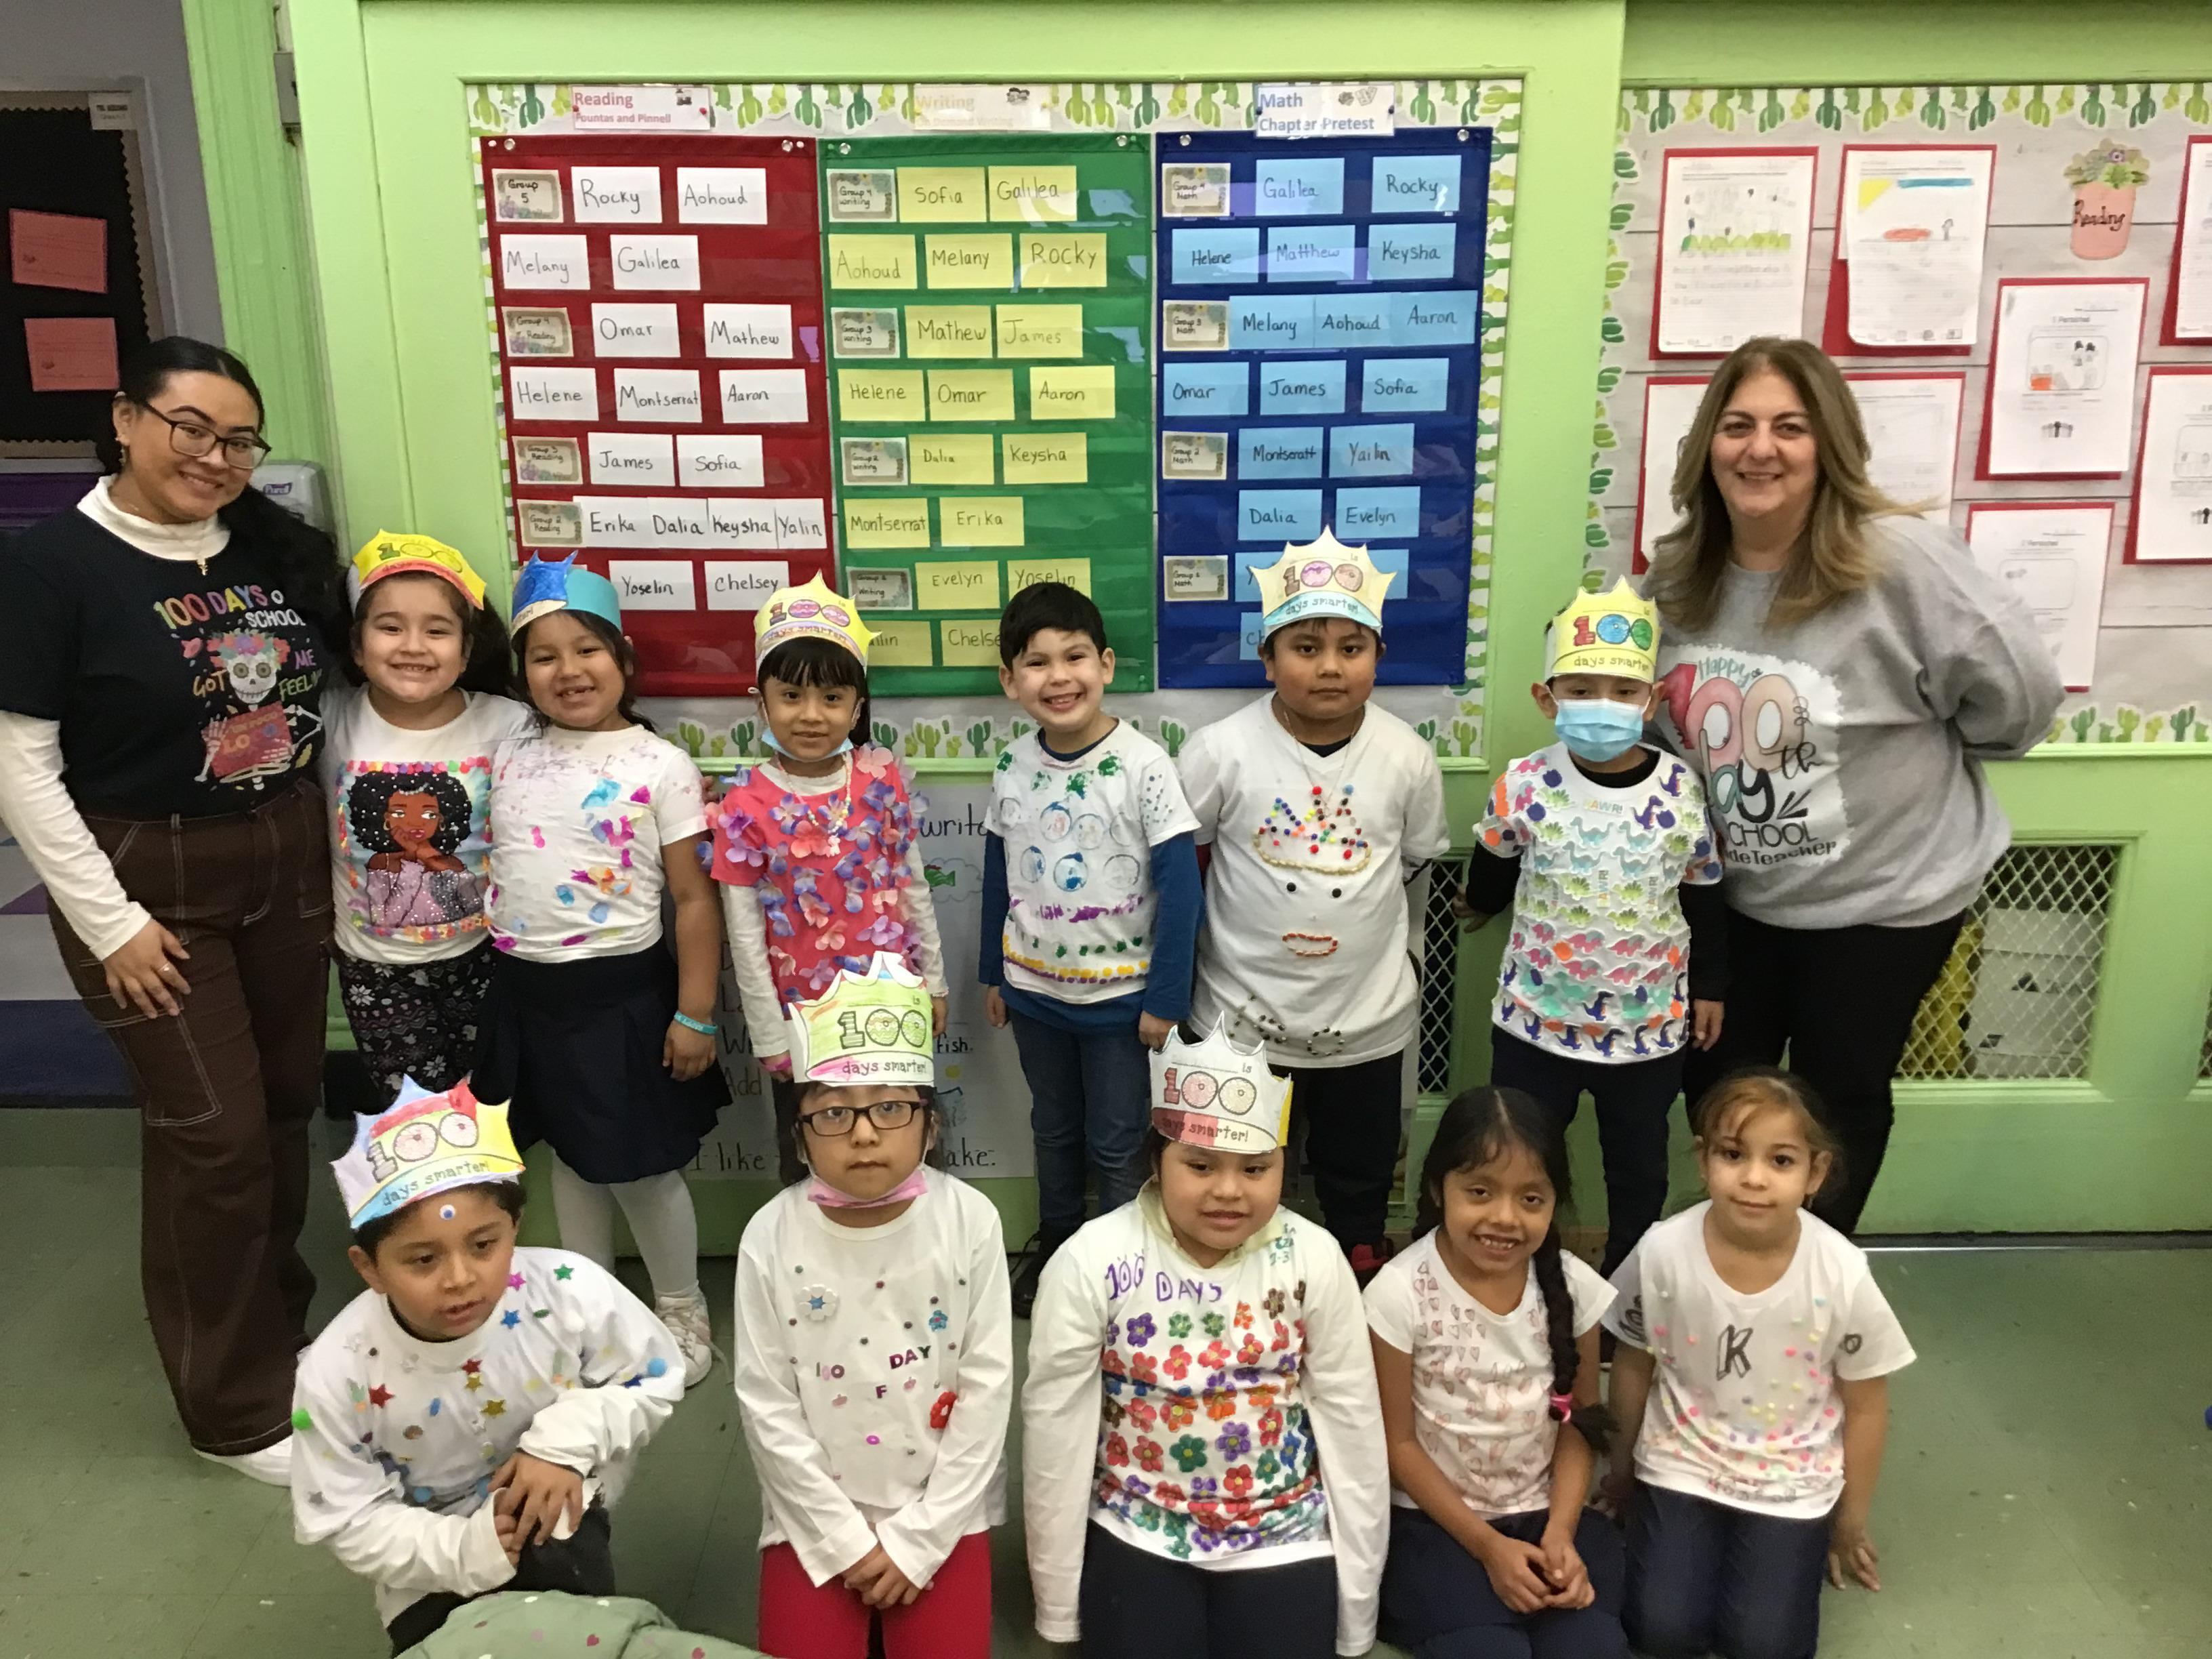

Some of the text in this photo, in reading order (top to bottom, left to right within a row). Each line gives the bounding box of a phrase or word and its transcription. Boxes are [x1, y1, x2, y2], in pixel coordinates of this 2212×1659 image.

[575, 93, 633, 108] Reading
[916, 96, 975, 110] Writing
[1260, 94, 1302, 108] Math
[617, 114, 634, 123] and
[638, 114, 671, 123] Pinnell
[1322, 118, 1375, 131] Pretest
[508, 180, 538, 190] Group
[840, 187, 863, 197] Group
[997, 178, 1059, 201] Galilea
[1174, 182, 1197, 192] Group
[1264, 177, 1318, 199] Galilea
[1387, 175, 1439, 201] Rocky
[521, 192, 529, 203] 5
[581, 179, 640, 213] Rocky
[915, 187, 962, 203] Sofia
[618, 247, 680, 272] Galilea
[933, 249, 989, 270] Melany
[1031, 241, 1097, 268] Rocky
[1193, 251, 1231, 264] Helene
[1277, 245, 1340, 261] Matthew
[1382, 241, 1440, 262] Keysha
[507, 251, 568, 283] Melany
[516, 316, 541, 326] Group
[600, 318, 652, 340] Omar
[842, 325, 865, 333] Group
[918, 320, 987, 340] Mathew
[1174, 317, 1194, 327] Group
[1243, 318, 1296, 340] Melany
[1408, 305, 1458, 325] Aaron
[712, 321, 779, 345] Mathew
[1003, 319, 1061, 344] James
[518, 382, 582, 403] Helene
[728, 383, 769, 401] Aaron
[851, 384, 906, 400] Helene
[938, 384, 987, 403] Omar
[1039, 382, 1085, 401] Aaron
[1173, 384, 1215, 399] Omar
[1269, 380, 1326, 397] James
[1375, 378, 1418, 396] Sofia
[600, 451, 653, 470] James
[853, 453, 872, 463] Group
[924, 449, 954, 463] Dalia
[1011, 445, 1067, 464] Keysha
[1172, 446, 1192, 456] Group
[696, 455, 741, 472] Sofia
[530, 515, 552, 525] Group
[590, 512, 822, 537] Erika Dalia Keysha Yalin
[851, 514, 926, 531] Montserrat
[958, 511, 1003, 526] Erika
[1251, 509, 1297, 524] Dalia
[1347, 508, 1395, 526] Evelyn
[621, 575, 674, 596] Yoselin
[715, 573, 779, 592] Chelsey
[933, 572, 983, 586] Evelyn
[1283, 560, 1364, 597] 100
[153, 584, 284, 630] 100 DAYS O
[769, 598, 851, 628] 100
[949, 629, 1000, 647] Chelse
[1573, 614, 1653, 651] 100
[1574, 655, 1605, 668] days
[1698, 656, 1753, 688] Happy
[192, 669, 228, 698] GOT
[1658, 663, 1805, 774] 100
[1729, 821, 1818, 848] CHOOL
[1727, 841, 1837, 865] deTeacher
[912, 995, 920, 1006] is
[837, 1008, 928, 1050] 100
[842, 1061, 879, 1076] days
[1242, 1062, 1252, 1073] is
[1164, 1067, 1257, 1115] 100
[1188, 1122, 1248, 1143] smarter!
[366, 1111, 479, 1183] 100
[717, 1142, 766, 1170] like
[947, 1139, 997, 1167] ake.
[382, 1181, 419, 1207] days
[1105, 1254, 1222, 1303] 100 DAYS
[888, 1345, 931, 1370] DAY
[1716, 1324, 1754, 1381] K
[876, 1385, 887, 1399] F
